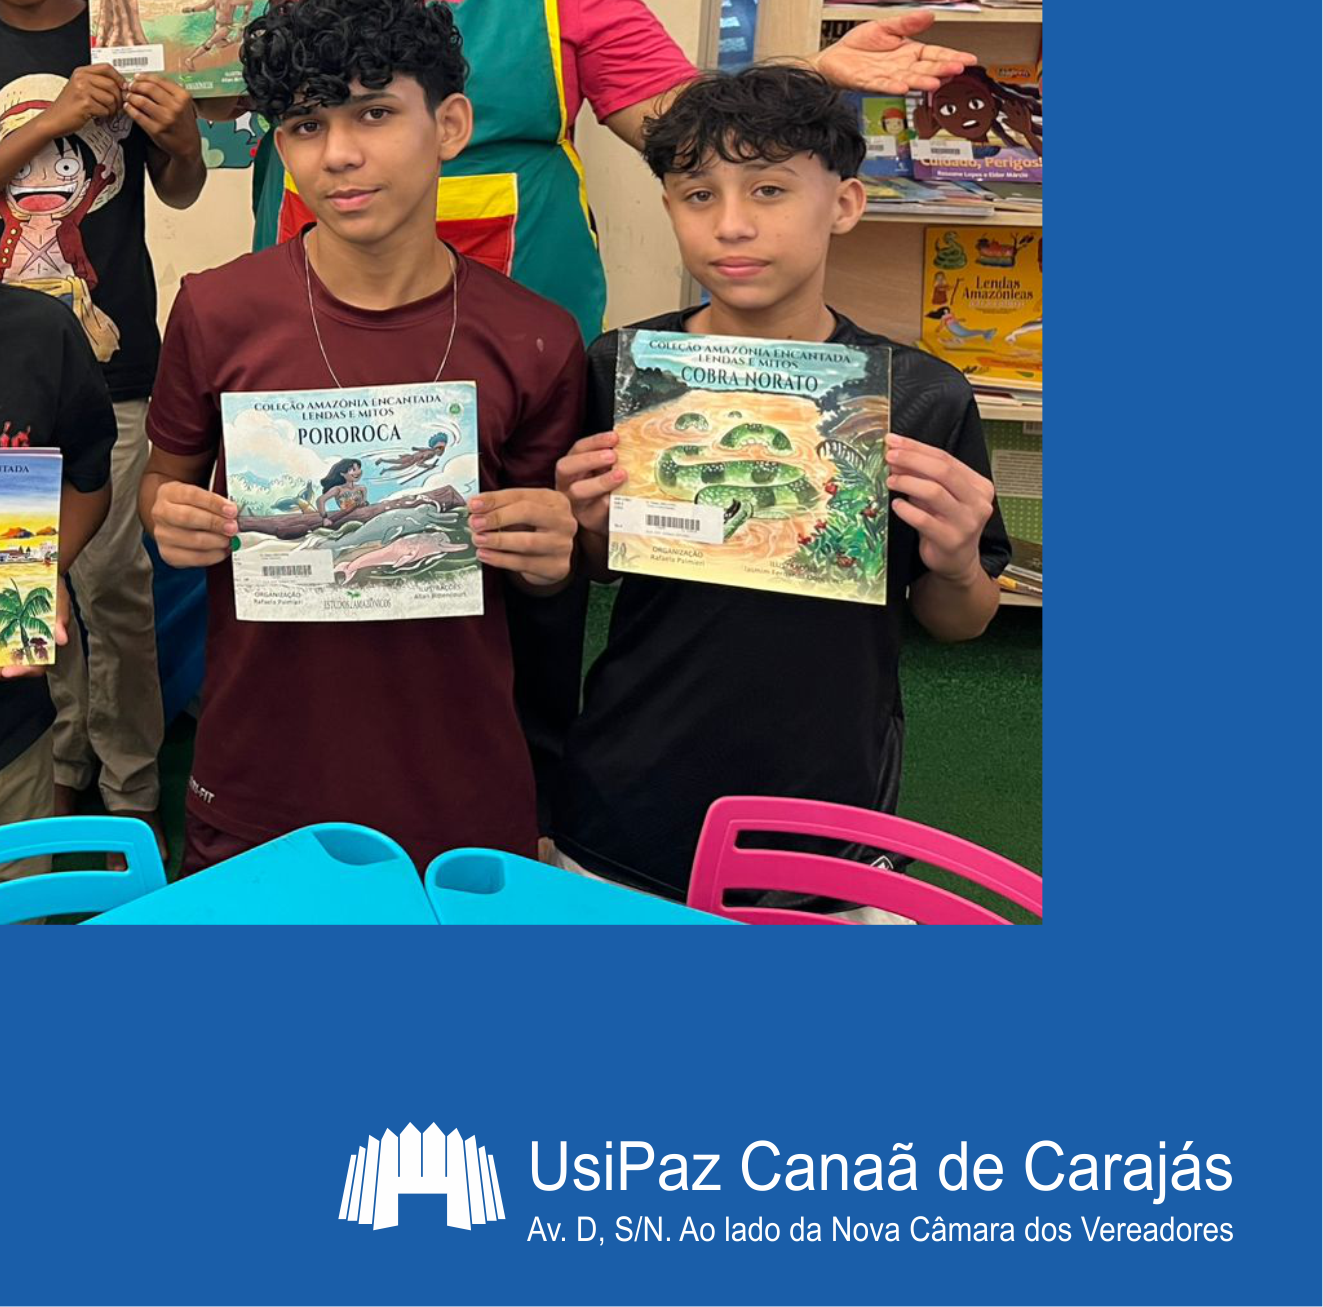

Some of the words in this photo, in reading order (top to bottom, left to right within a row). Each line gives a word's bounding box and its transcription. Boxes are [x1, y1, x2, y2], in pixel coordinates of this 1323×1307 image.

[976, 276, 1021, 290] Lendas
[649, 340, 703, 353] COLEÇÃO
[704, 343, 772, 359] AMAZÔNIA
[773, 349, 852, 364] ENCANTADA
[698, 354, 746, 366] LENDAS
[748, 357, 756, 366] E
[757, 358, 799, 369] MITOS
[680, 366, 739, 386] COBRA
[744, 371, 819, 392] NORATO
[254, 400, 305, 412] COLEÇÃO
[306, 397, 370, 410] AMAZÔNIA
[371, 394, 442, 407] ENCANTADA
[302, 410, 347, 421] LENDAS
[348, 409, 356, 418] E
[357, 408, 395, 418] MITOS
[297, 423, 402, 445] POROROCA
